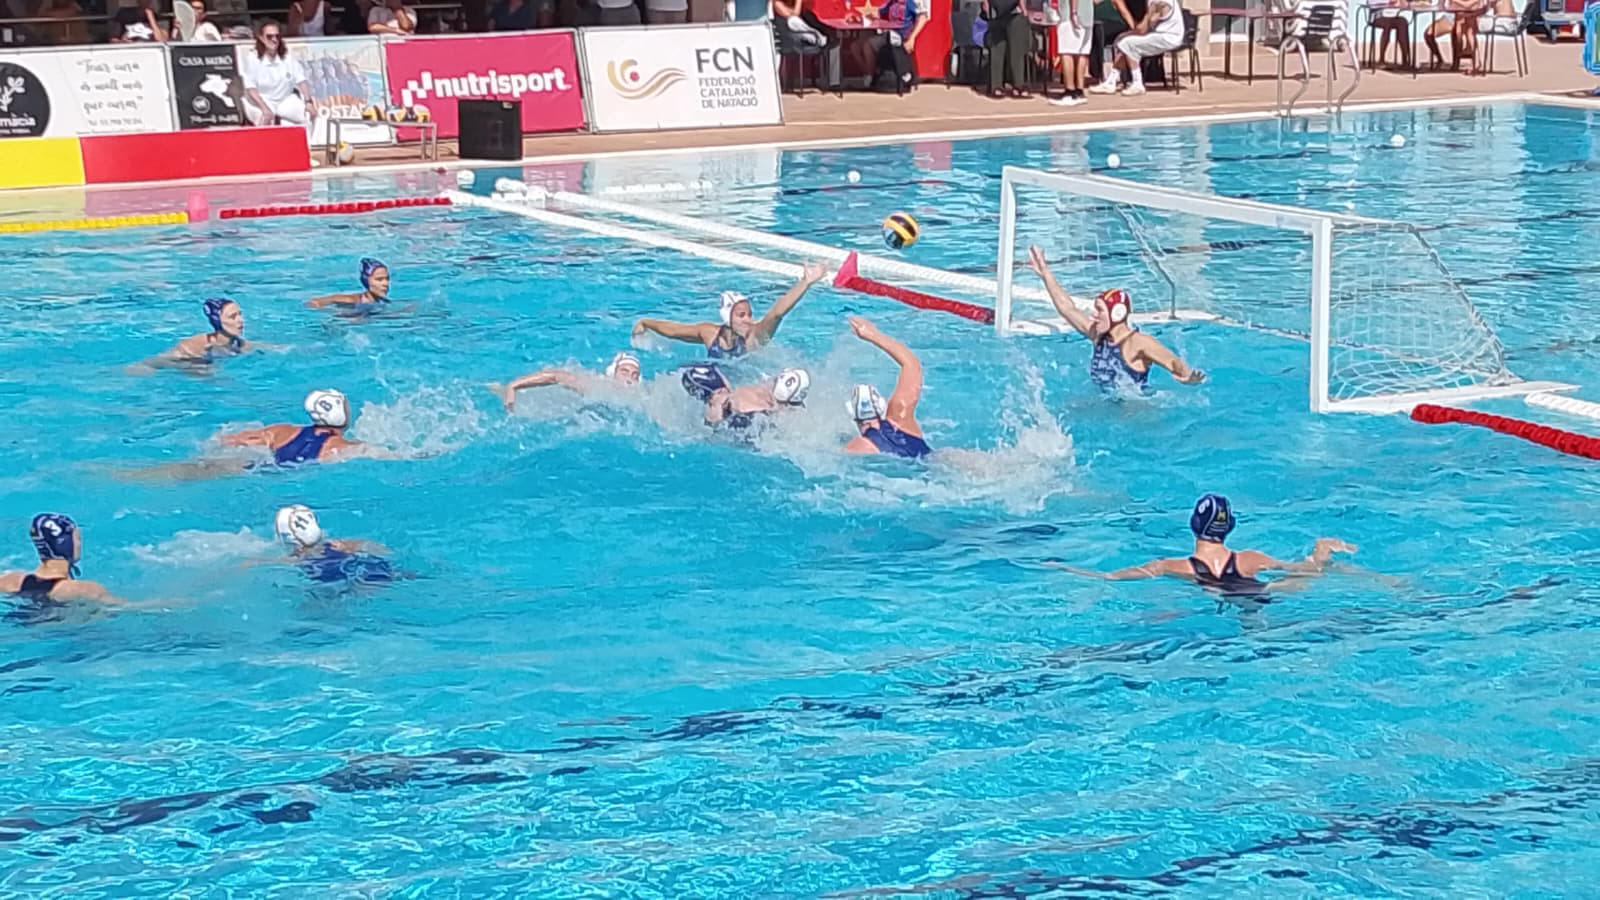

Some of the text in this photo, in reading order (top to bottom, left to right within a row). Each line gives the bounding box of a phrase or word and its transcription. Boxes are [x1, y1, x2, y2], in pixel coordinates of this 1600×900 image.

[695, 46, 754, 73] FCN
[434, 67, 566, 97] nutrisport
[699, 74, 756, 87] FEDERACIÓ
[700, 87, 757, 98] CATALANA
[702, 96, 759, 109] DE NATACIÓ
[785, 376, 796, 388] 6
[319, 399, 333, 412] 8
[45, 519, 62, 536] 3
[294, 514, 310, 530] 11
